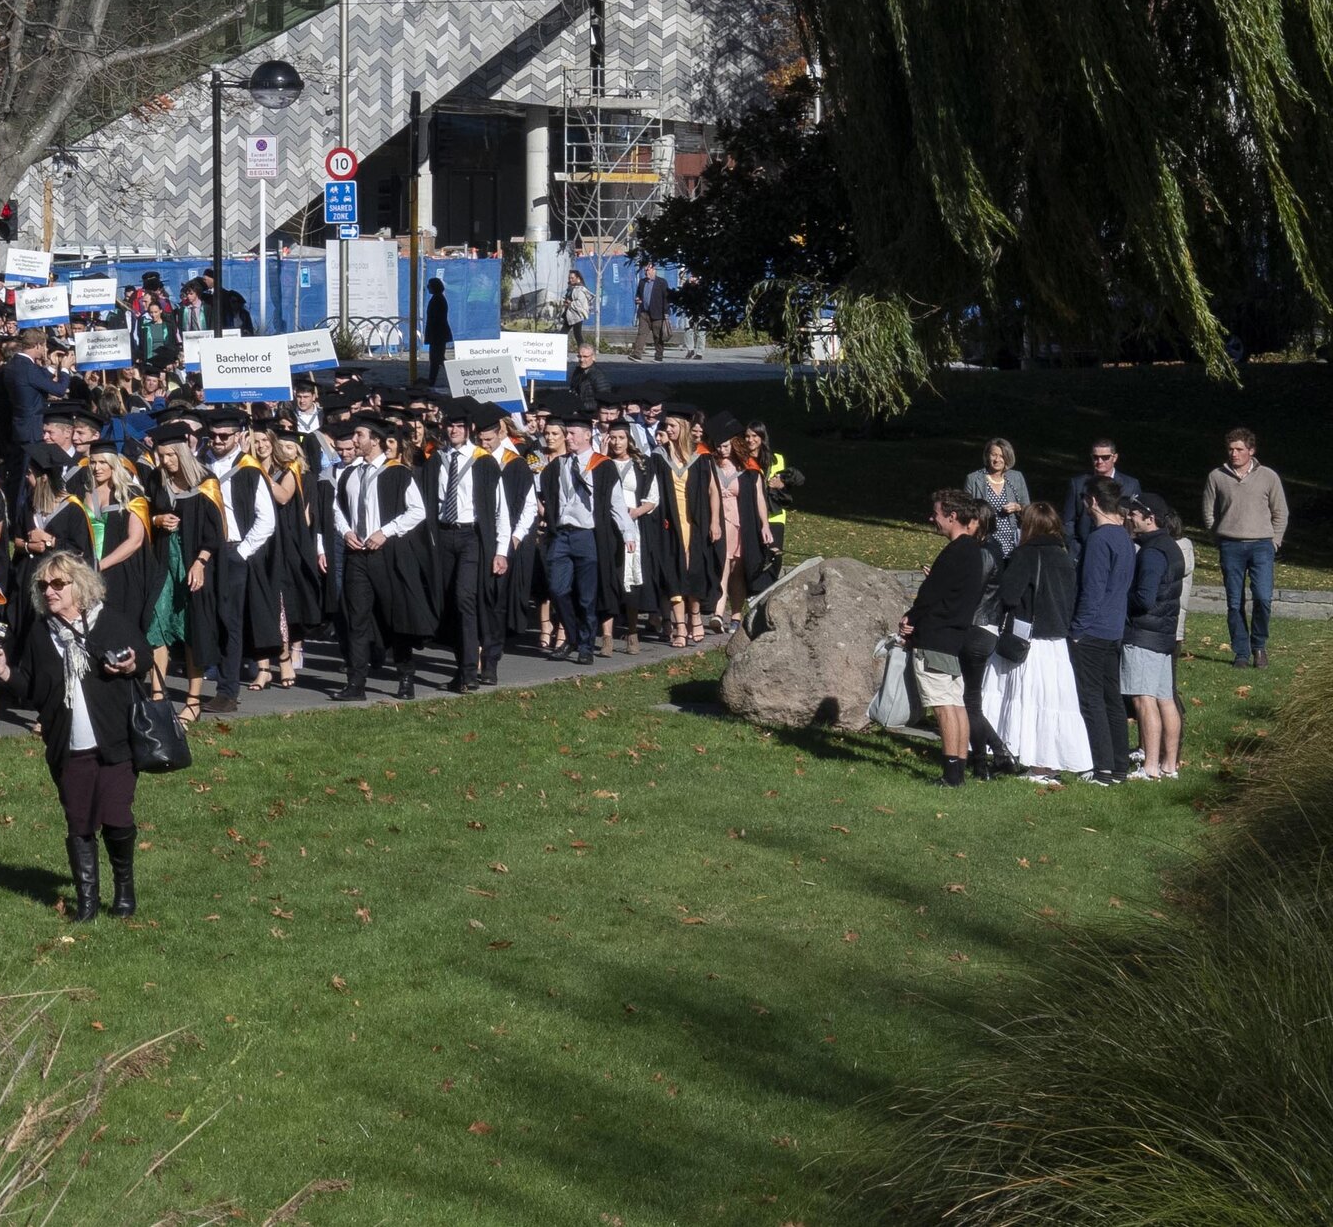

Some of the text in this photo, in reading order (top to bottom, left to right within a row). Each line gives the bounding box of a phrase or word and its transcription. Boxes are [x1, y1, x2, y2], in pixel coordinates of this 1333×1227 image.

[336, 158, 348, 170] 10
[216, 352, 271, 363] Bachelor of
[218, 365, 272, 374] Commerce
[460, 368, 491, 376] Bachelor
[464, 377, 502, 386] Commerce
[463, 385, 508, 396] (Agriculture)
